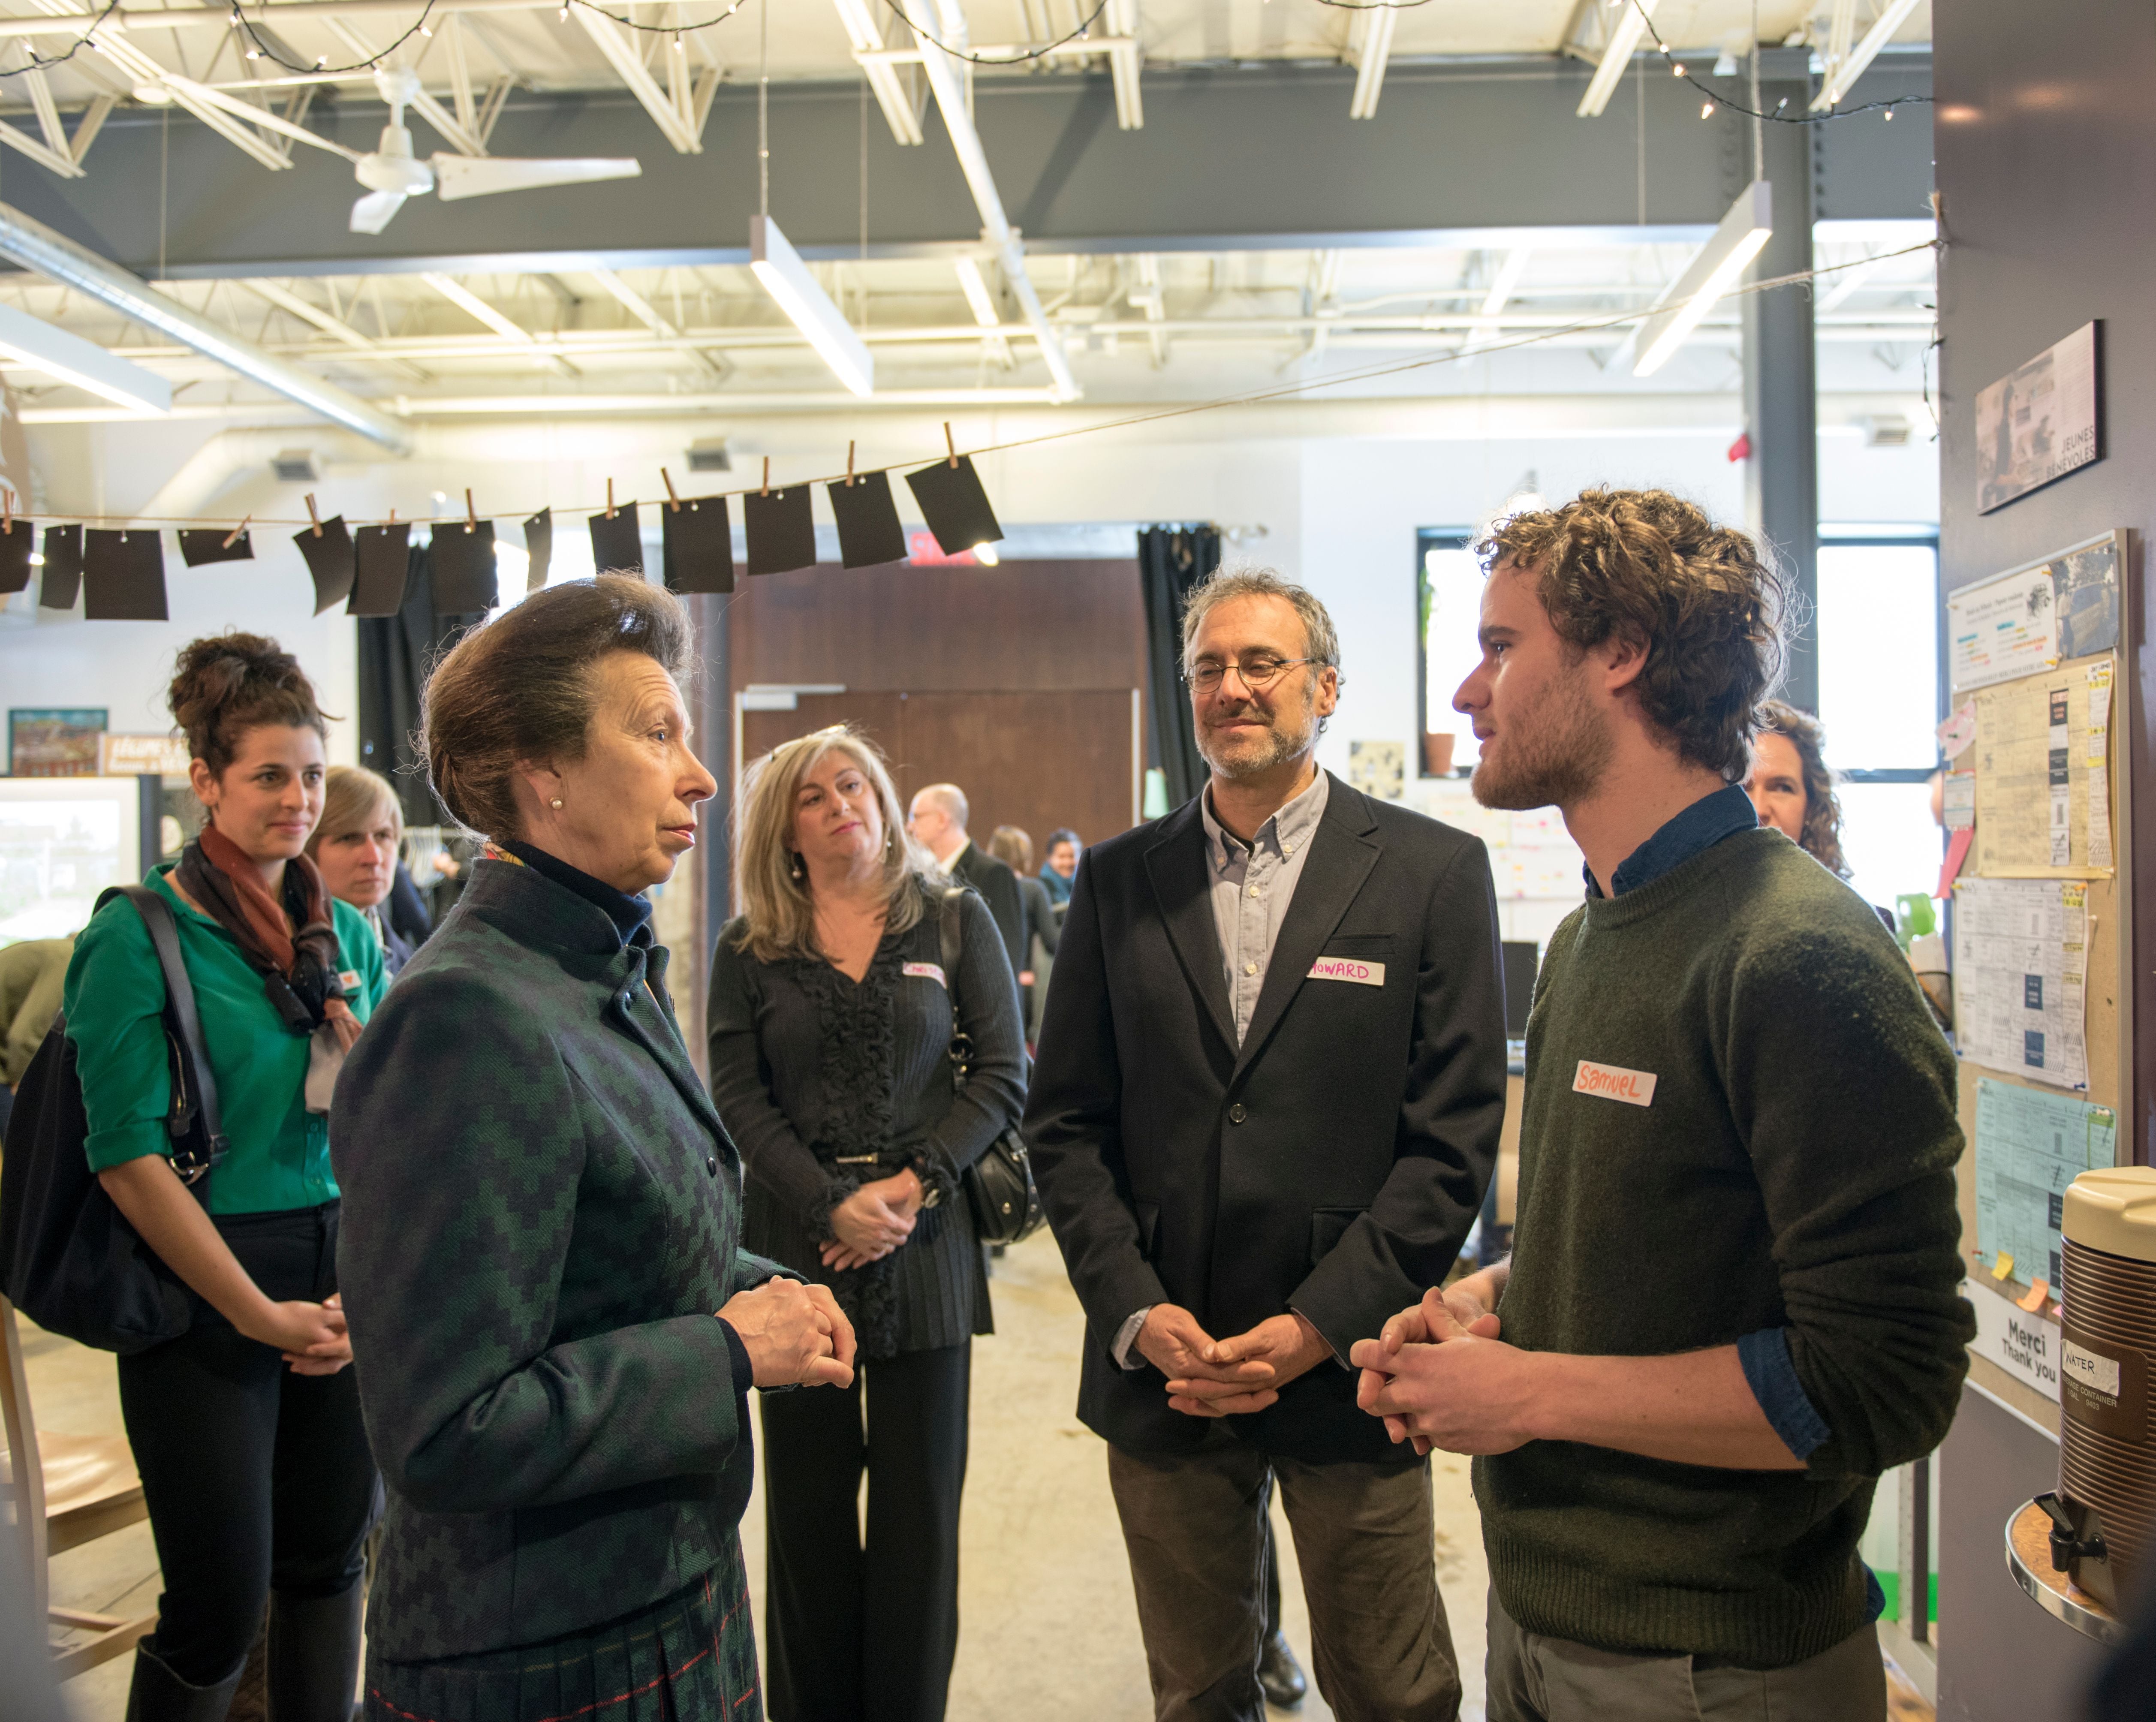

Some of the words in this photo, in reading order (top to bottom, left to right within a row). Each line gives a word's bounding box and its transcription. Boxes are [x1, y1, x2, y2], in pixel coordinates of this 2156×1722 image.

[2061, 425, 2094, 455] JEUNES
[2008, 1317, 2046, 1357] Merci
[2002, 1337, 2033, 1370] Thank
[2035, 1360, 2056, 1383] you
[2064, 1347, 2095, 1374] WATER
[2080, 1387, 2117, 1408] CONTAINER
[2086, 1399, 2099, 1411] 9403
